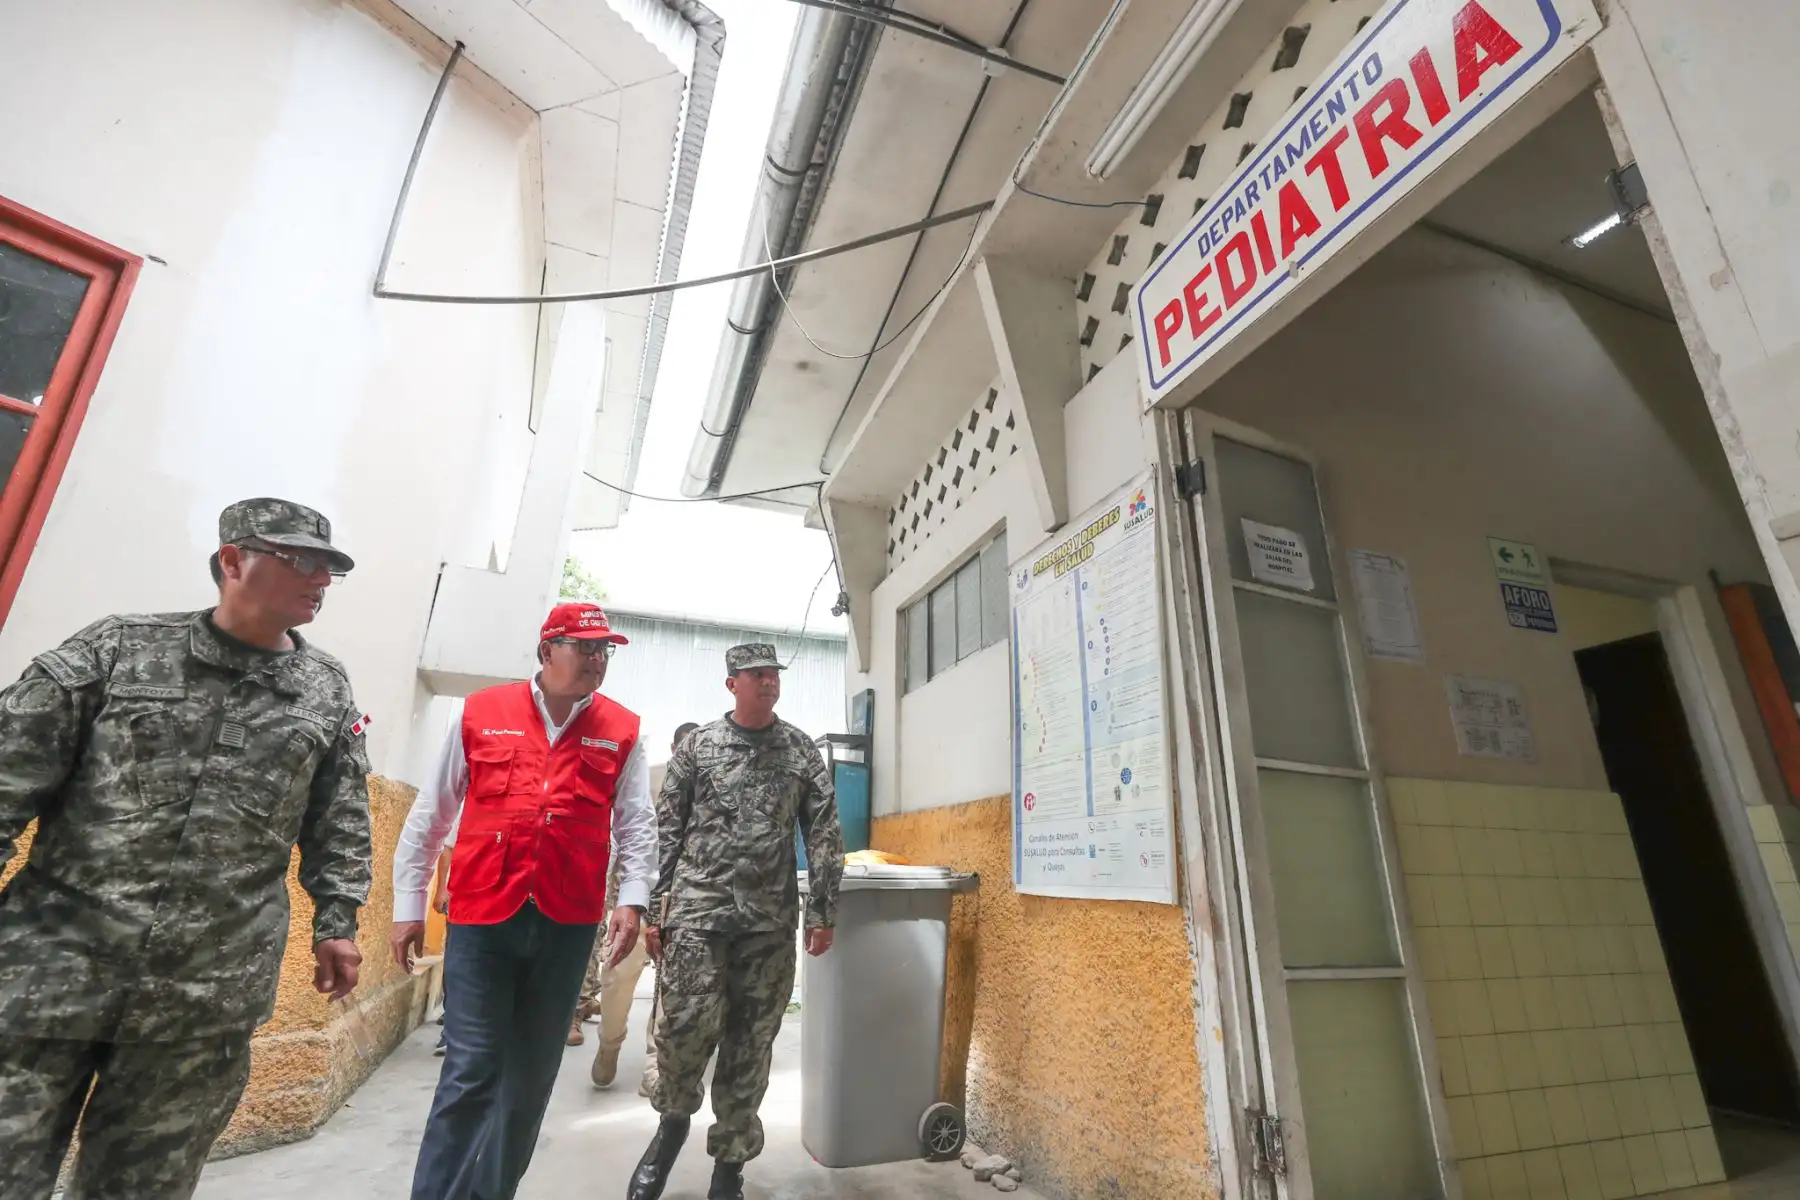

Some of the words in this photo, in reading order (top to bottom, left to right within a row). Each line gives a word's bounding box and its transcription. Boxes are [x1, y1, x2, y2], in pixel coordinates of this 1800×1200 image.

[1198, 51, 1384, 260] DEPARTAMENTO
[1153, 0, 1523, 368] PEDIATRIA
[1123, 507, 1154, 531] SUSALUD
[1033, 539, 1073, 576] DERECHOS
[1073, 533, 1081, 550] Y
[1081, 505, 1121, 546] DEBERES
[1054, 557, 1066, 579] EN
[1066, 542, 1095, 571] SALUD
[1504, 585, 1550, 610] AFORO
[578, 619, 590, 627] DE
[119, 687, 174, 697] MONTOYA
